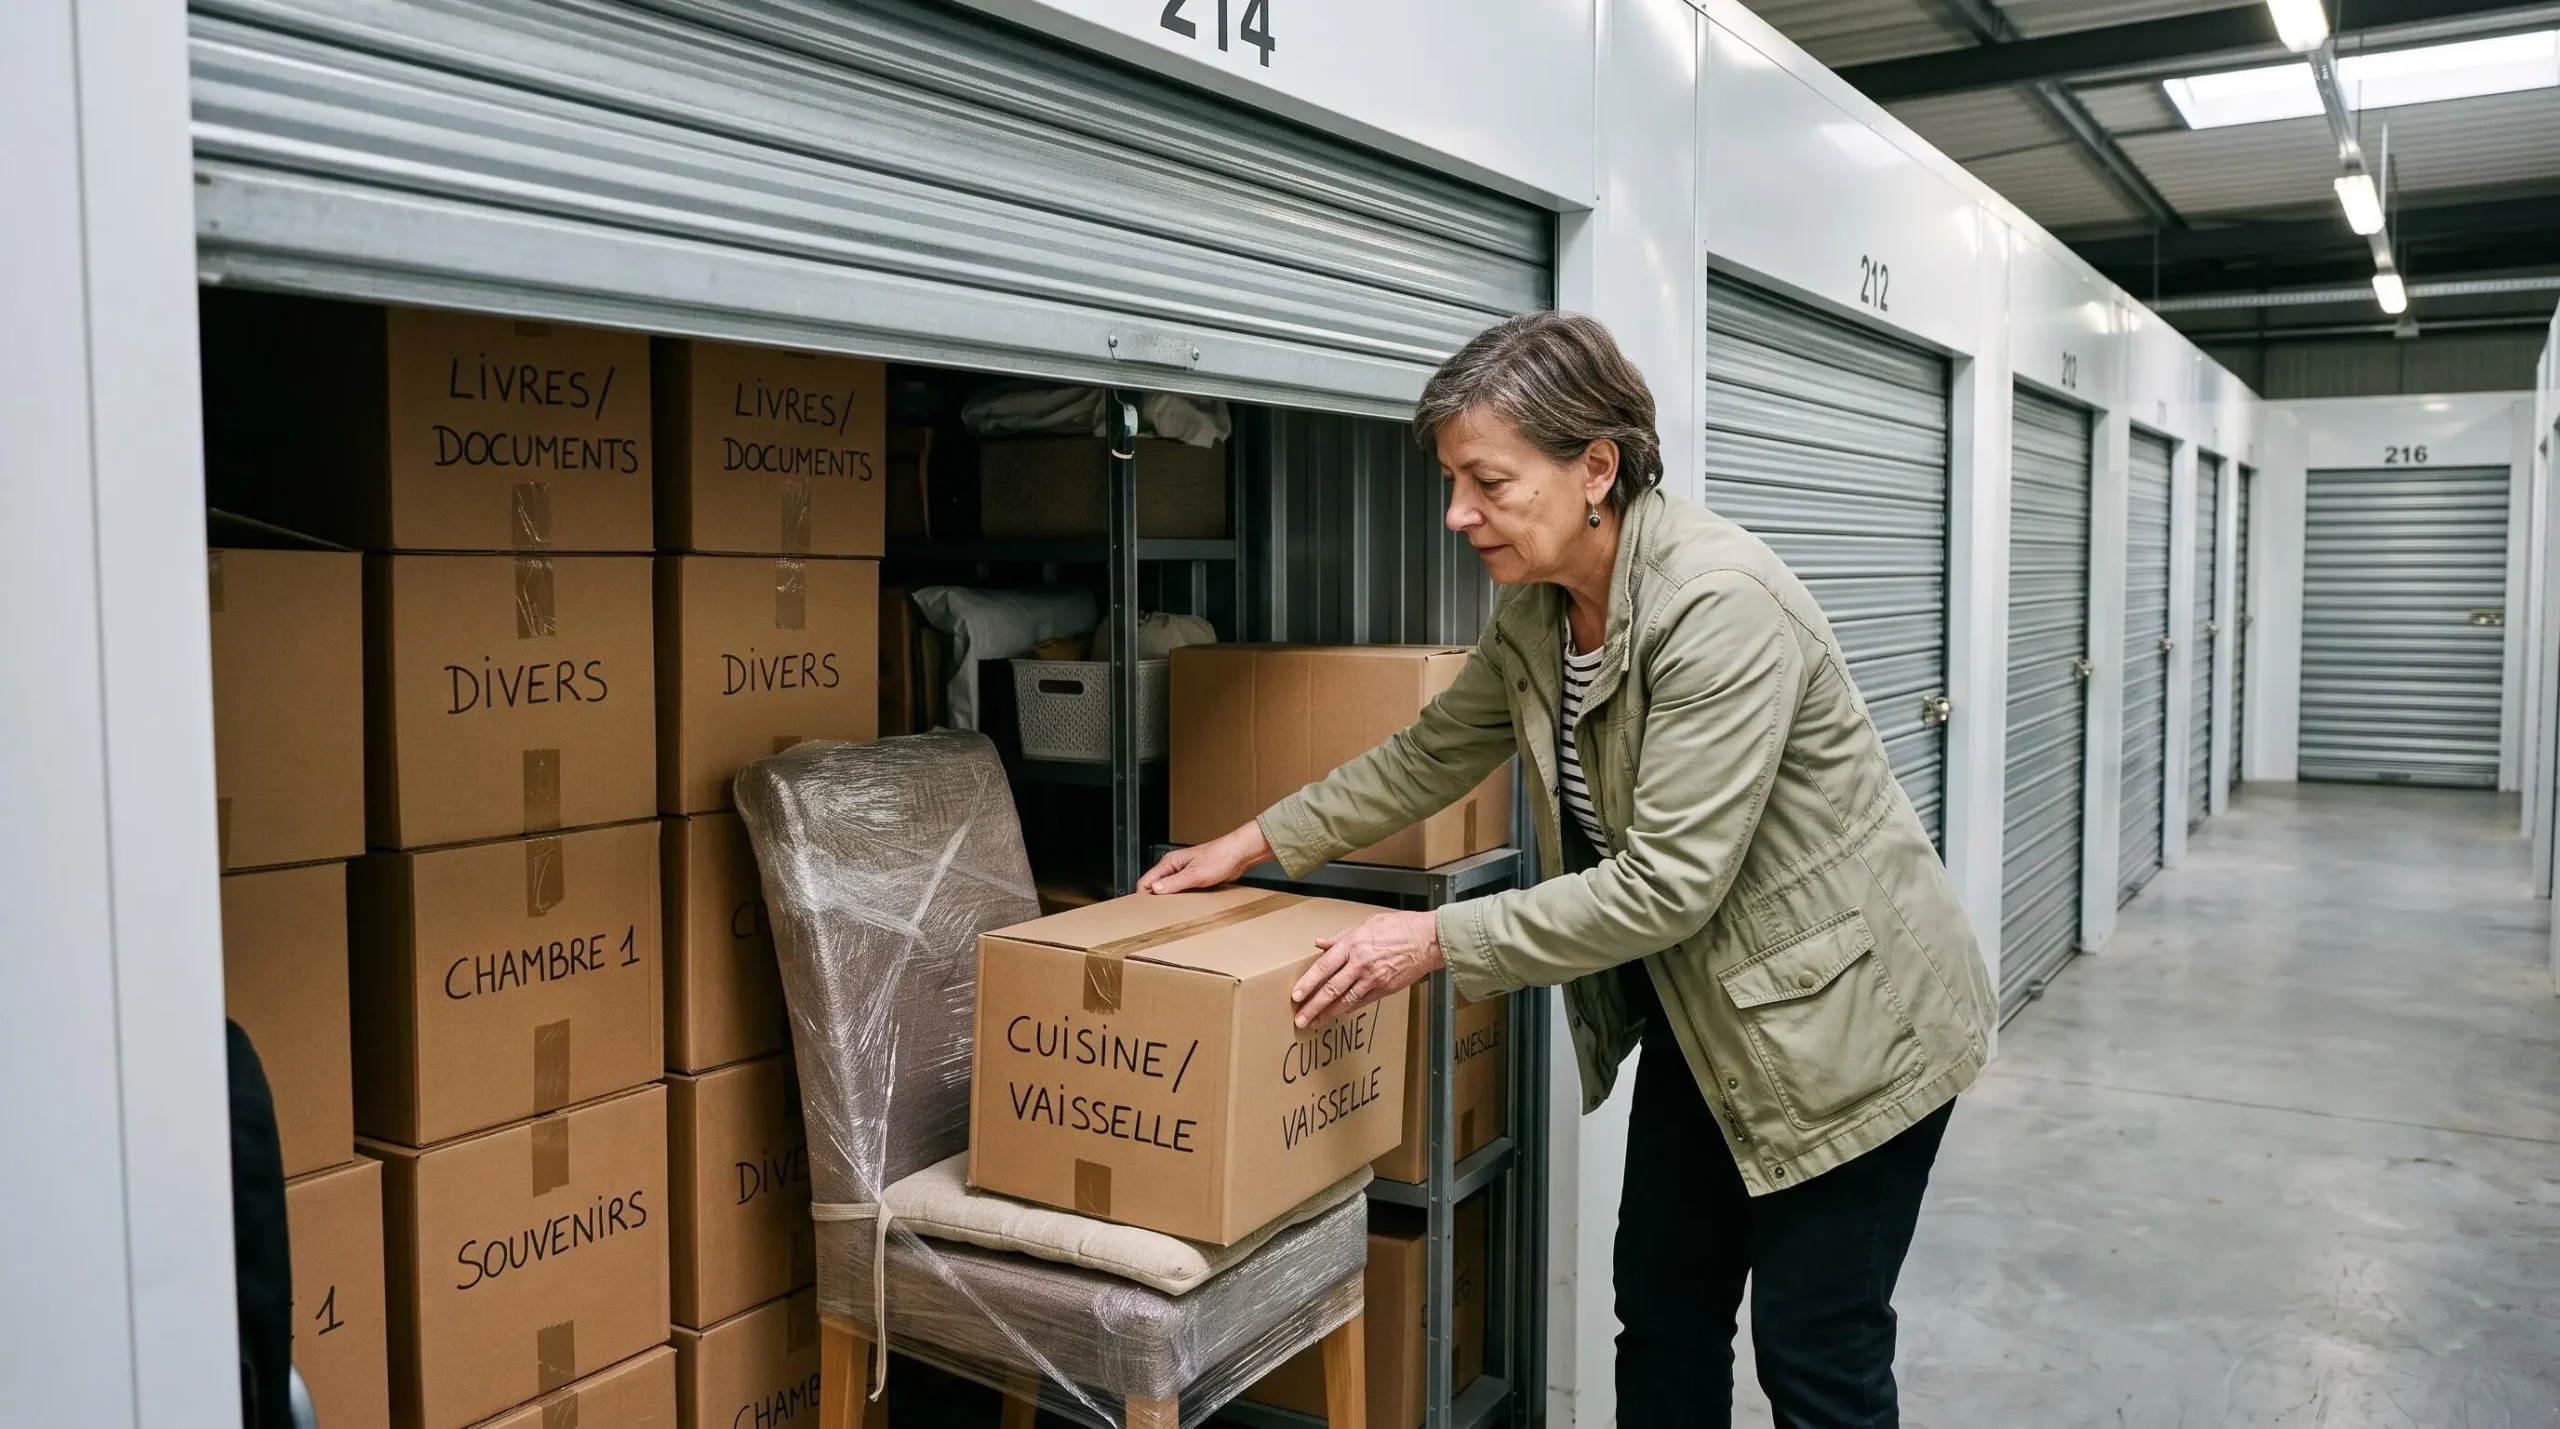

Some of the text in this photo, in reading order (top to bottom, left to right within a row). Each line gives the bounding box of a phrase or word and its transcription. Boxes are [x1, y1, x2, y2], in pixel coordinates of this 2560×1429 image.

[1860, 254, 1889, 312] 212
[432, 425, 639, 474] DOCUMENTS
[722, 437, 873, 482] DOCUMENTS
[2384, 444, 2428, 464] 216
[445, 924, 640, 1000] CHAMBRE 1
[735, 1146, 809, 1206] DIVE
[315, 1285, 345, 1336] 1
[734, 1373, 821, 1429] CHAMB
